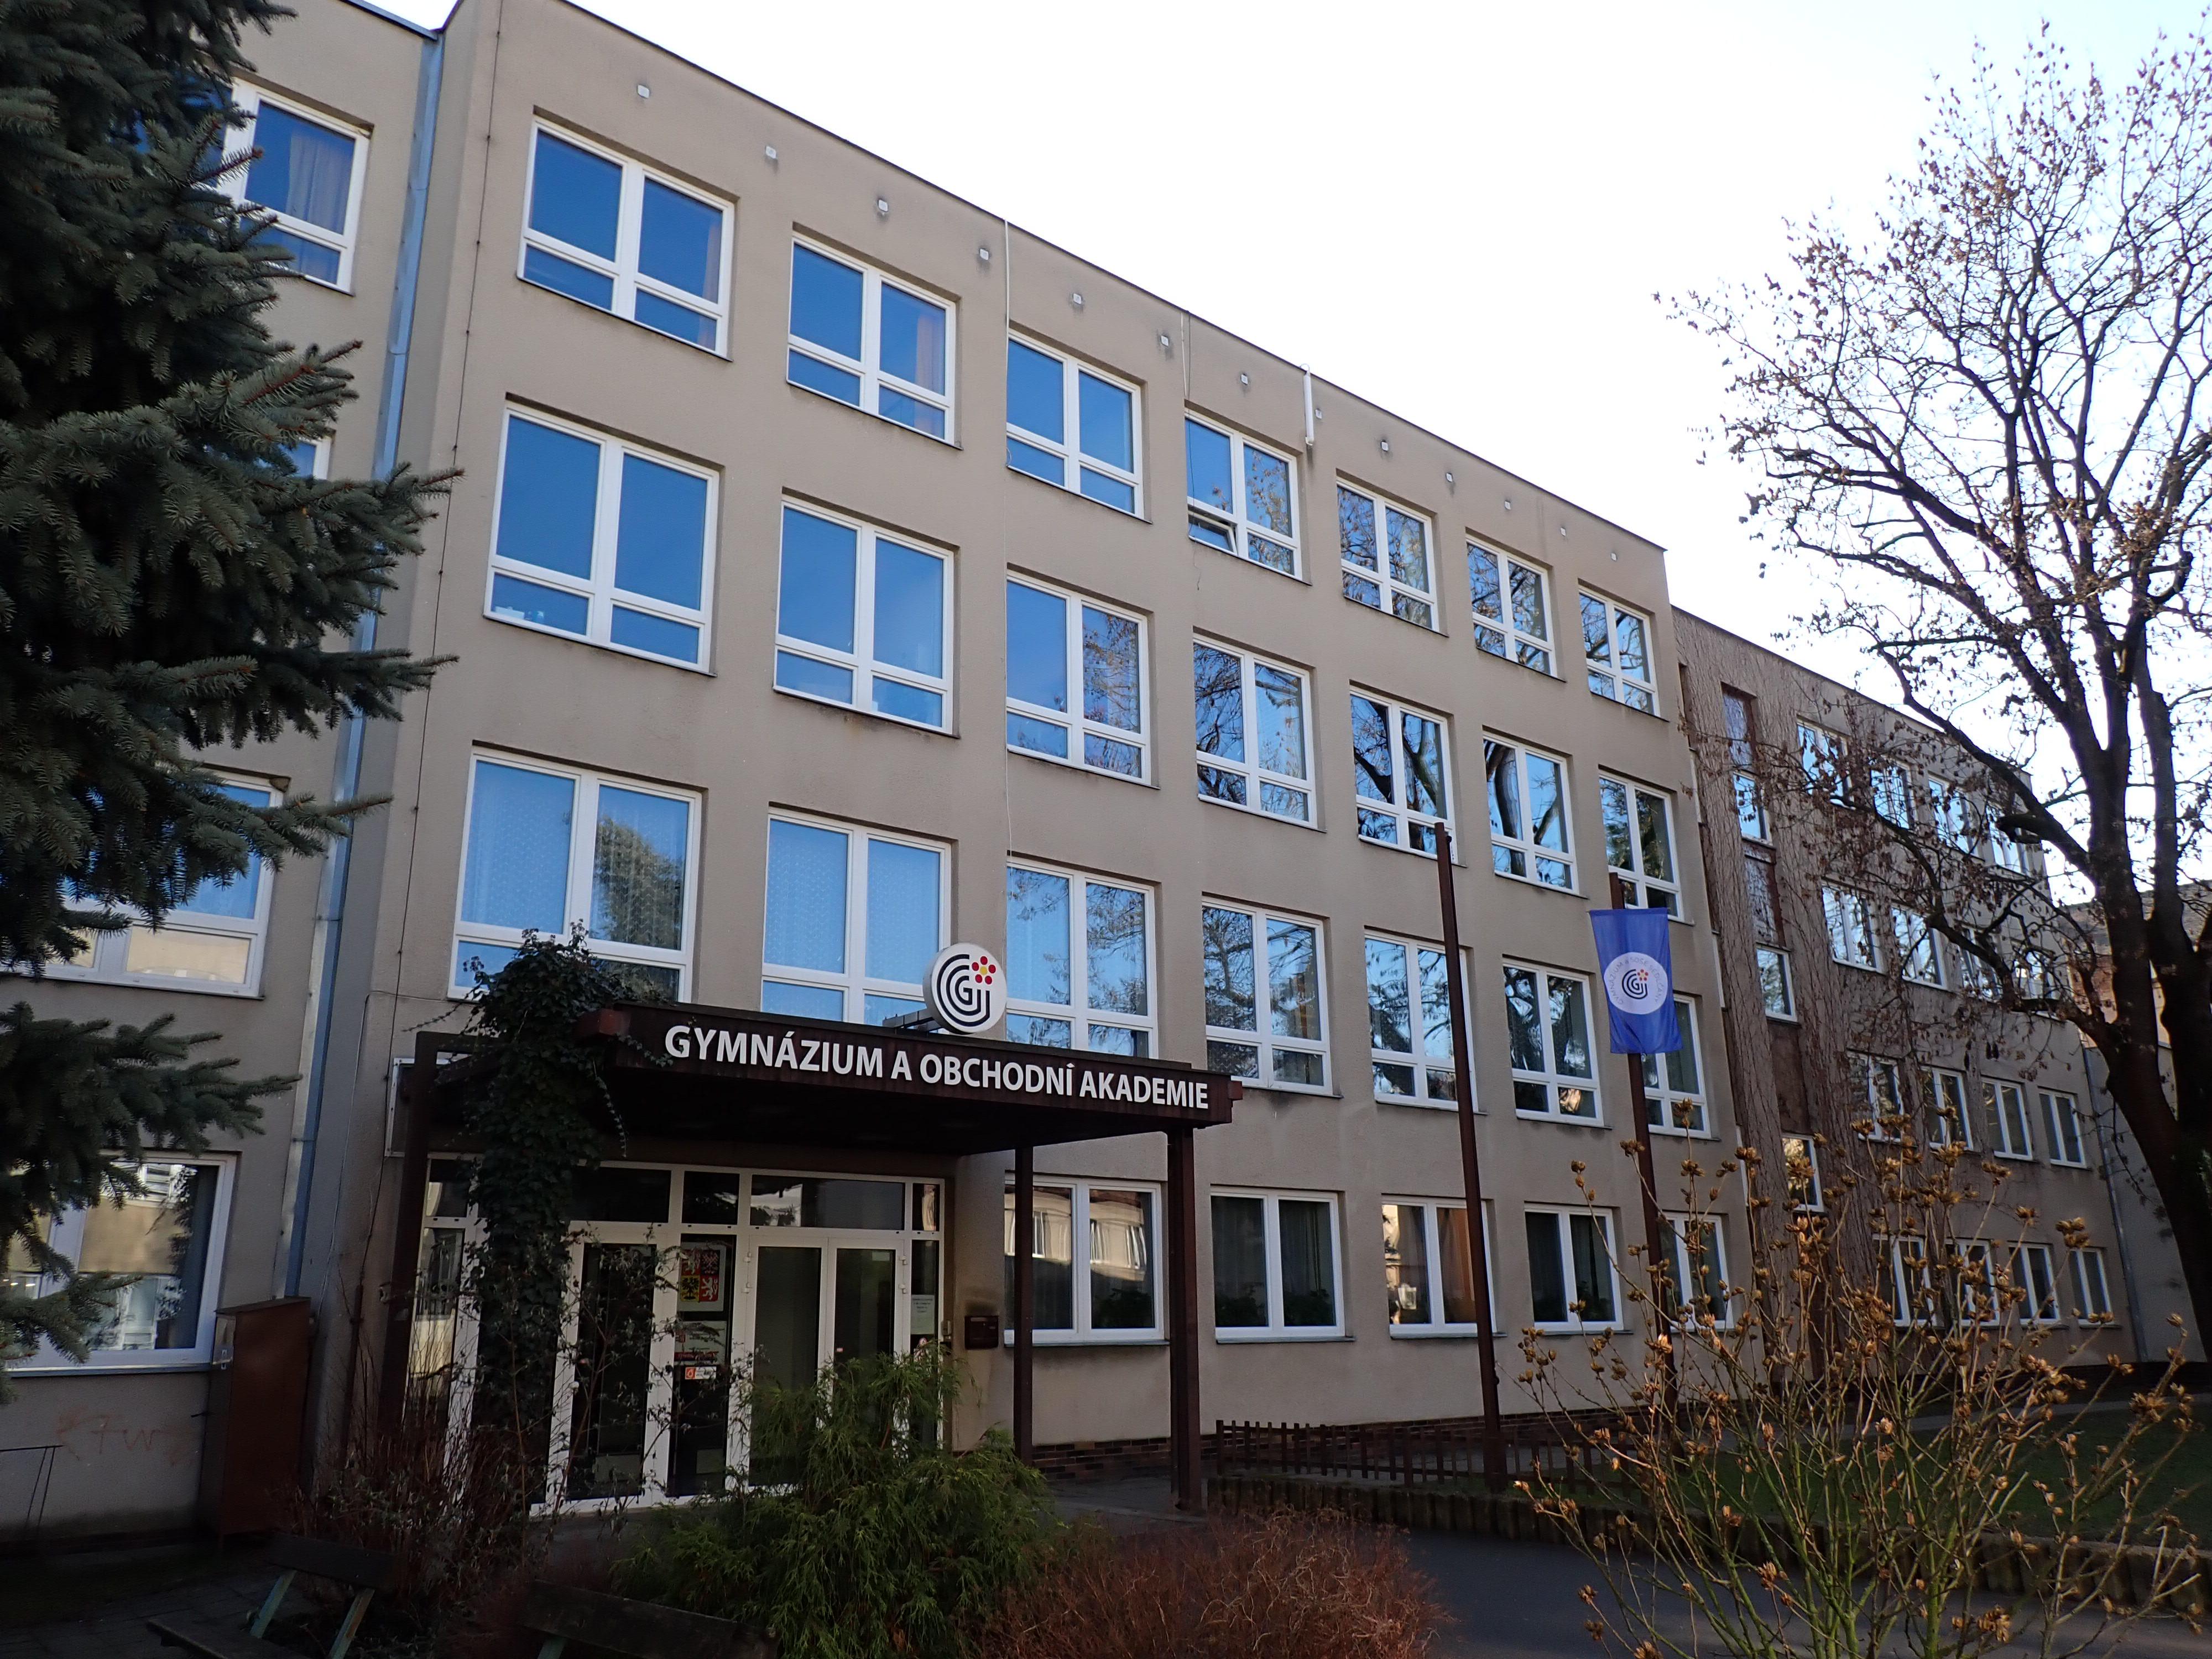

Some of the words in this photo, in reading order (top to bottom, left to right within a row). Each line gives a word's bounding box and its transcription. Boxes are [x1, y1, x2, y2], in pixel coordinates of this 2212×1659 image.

[665, 1025, 883, 1078] GYMNÁZIUM
[890, 1051, 912, 1081] A
[920, 1053, 1074, 1096] OBCHODNÍ
[1079, 1071, 1209, 1109] AKADEMIE
